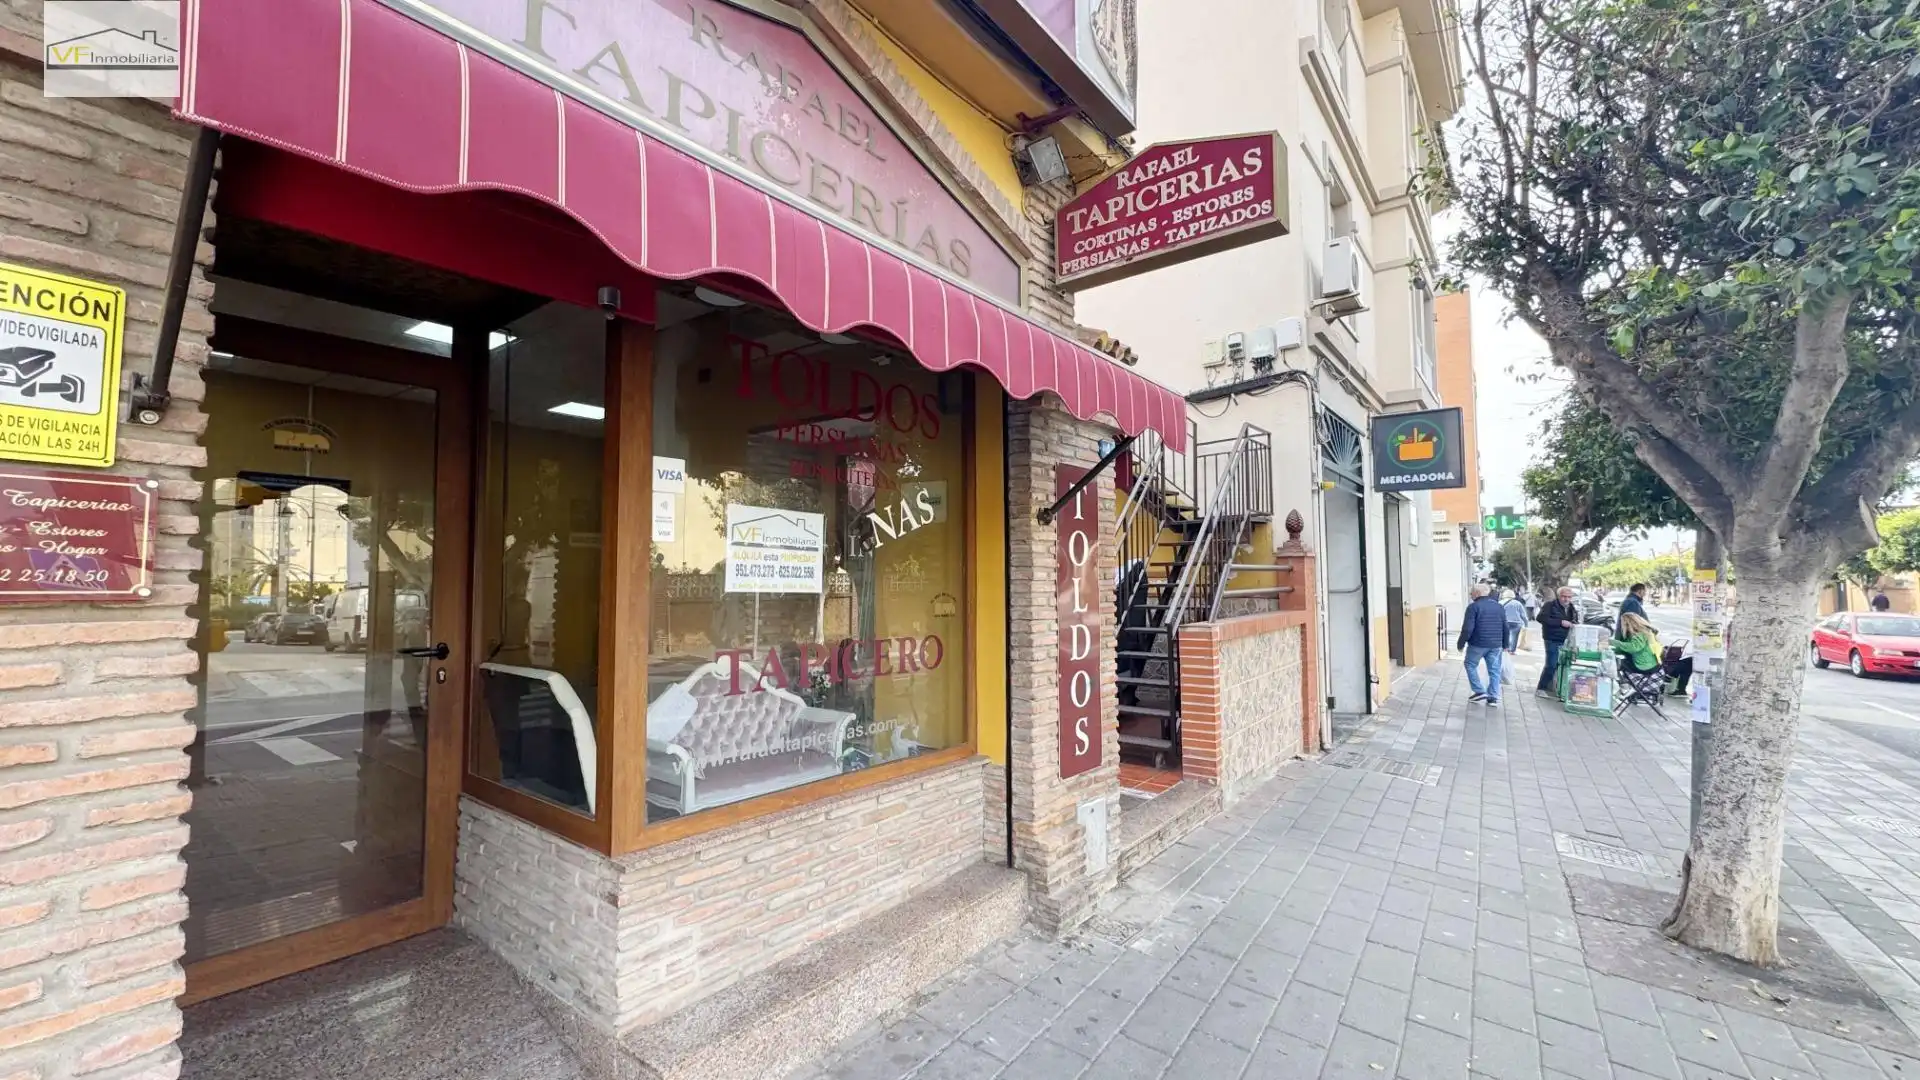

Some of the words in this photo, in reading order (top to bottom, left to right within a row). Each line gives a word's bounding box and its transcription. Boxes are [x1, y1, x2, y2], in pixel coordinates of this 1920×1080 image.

[687, 3, 888, 162] RAFAEL
[1115, 146, 1200, 190] RAFAEL
[1066, 147, 1263, 235] TAPICERIAS
[1073, 217, 1158, 254] CORTINAS
[1172, 186, 1255, 224] ESTORES
[1061, 237, 1150, 275] PERSIANAS
[1164, 199, 1273, 244] TAPIZADOS
[726, 333, 941, 440] TOLDOS
[7, 415, 25, 428] DE
[28, 417, 101, 436] VIGILANCIA
[47, 436, 72, 450] LAS
[77, 440, 100, 453] 24H
[656, 468, 684, 482] VISA
[1379, 471, 1456, 485] MERCADONA
[30, 520, 108, 537] Estores
[736, 526, 762, 542] VF
[39, 540, 108, 558] Hogar
[18, 569, 46, 582] 25
[54, 569, 77, 582] 18
[84, 569, 109, 582] 50
[1068, 480, 1093, 757] TOLDOS
[715, 634, 944, 697] TAPICERO
